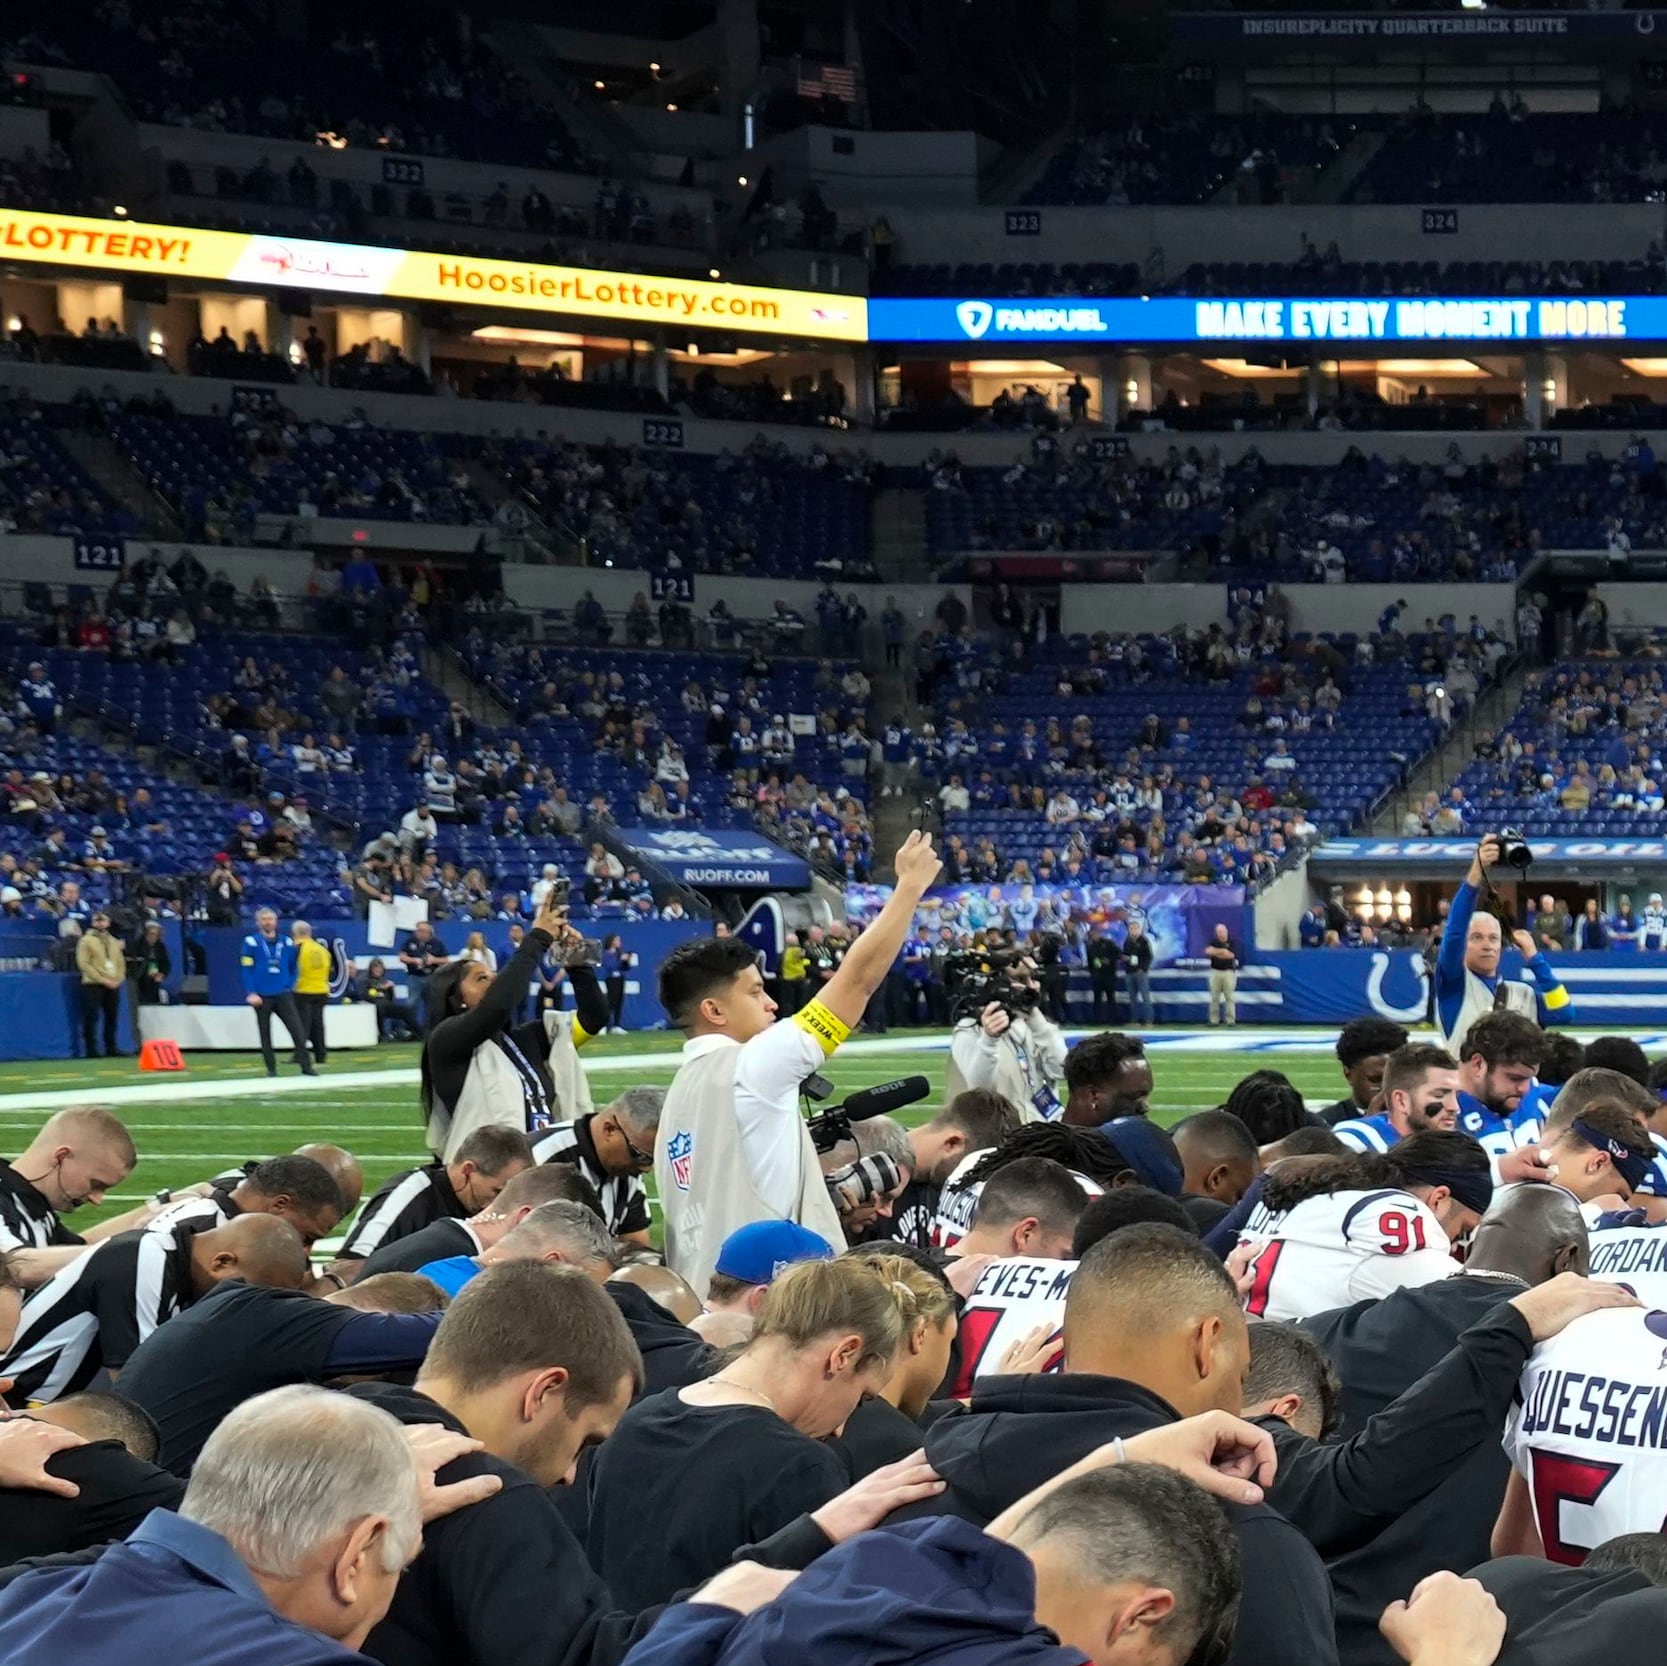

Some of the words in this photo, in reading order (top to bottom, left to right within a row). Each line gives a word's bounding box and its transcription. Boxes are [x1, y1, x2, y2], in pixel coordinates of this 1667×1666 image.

[1382, 18, 1512, 35] QUARTERBACK
[1514, 18, 1569, 33] SUITE
[0, 222, 191, 263] LOTTERY!
[438, 263, 781, 320] HoosierLottery.com
[996, 308, 1107, 331] FANDUEL
[1196, 302, 1284, 337] MAKE
[1291, 301, 1389, 338] EVERY
[1396, 301, 1531, 338] MOMENT
[1540, 301, 1626, 338] MORE
[645, 423, 681, 442] 222
[79, 545, 120, 565] 121
[653, 577, 692, 597] 121
[1564, 842, 1665, 857] OIL
[683, 867, 770, 884] RUOFF.COM
[152, 1044, 181, 1067] 10
[1378, 1211, 1427, 1256] 91
[975, 1264, 1069, 1301] EVES-M
